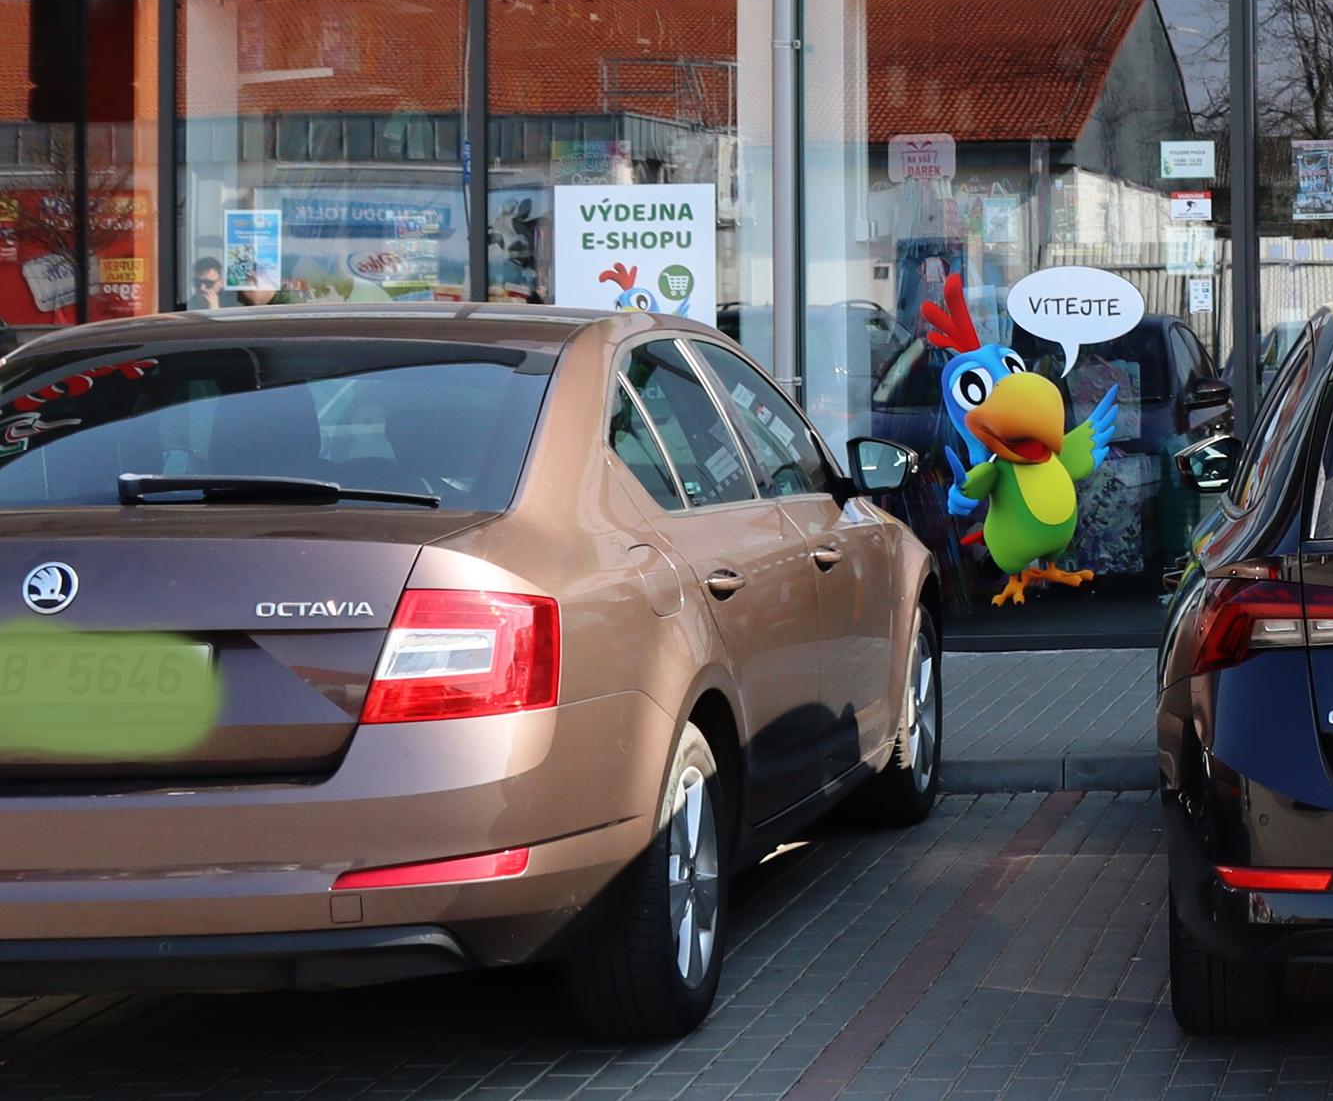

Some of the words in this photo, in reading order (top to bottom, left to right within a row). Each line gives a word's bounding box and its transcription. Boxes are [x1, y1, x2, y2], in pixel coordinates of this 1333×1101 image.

[580, 198, 694, 222] VÝDEJNA
[582, 230, 693, 250] E-SHOPU
[1028, 294, 1121, 317] VÍTEJTE
[255, 600, 375, 617] OCTAVIA
